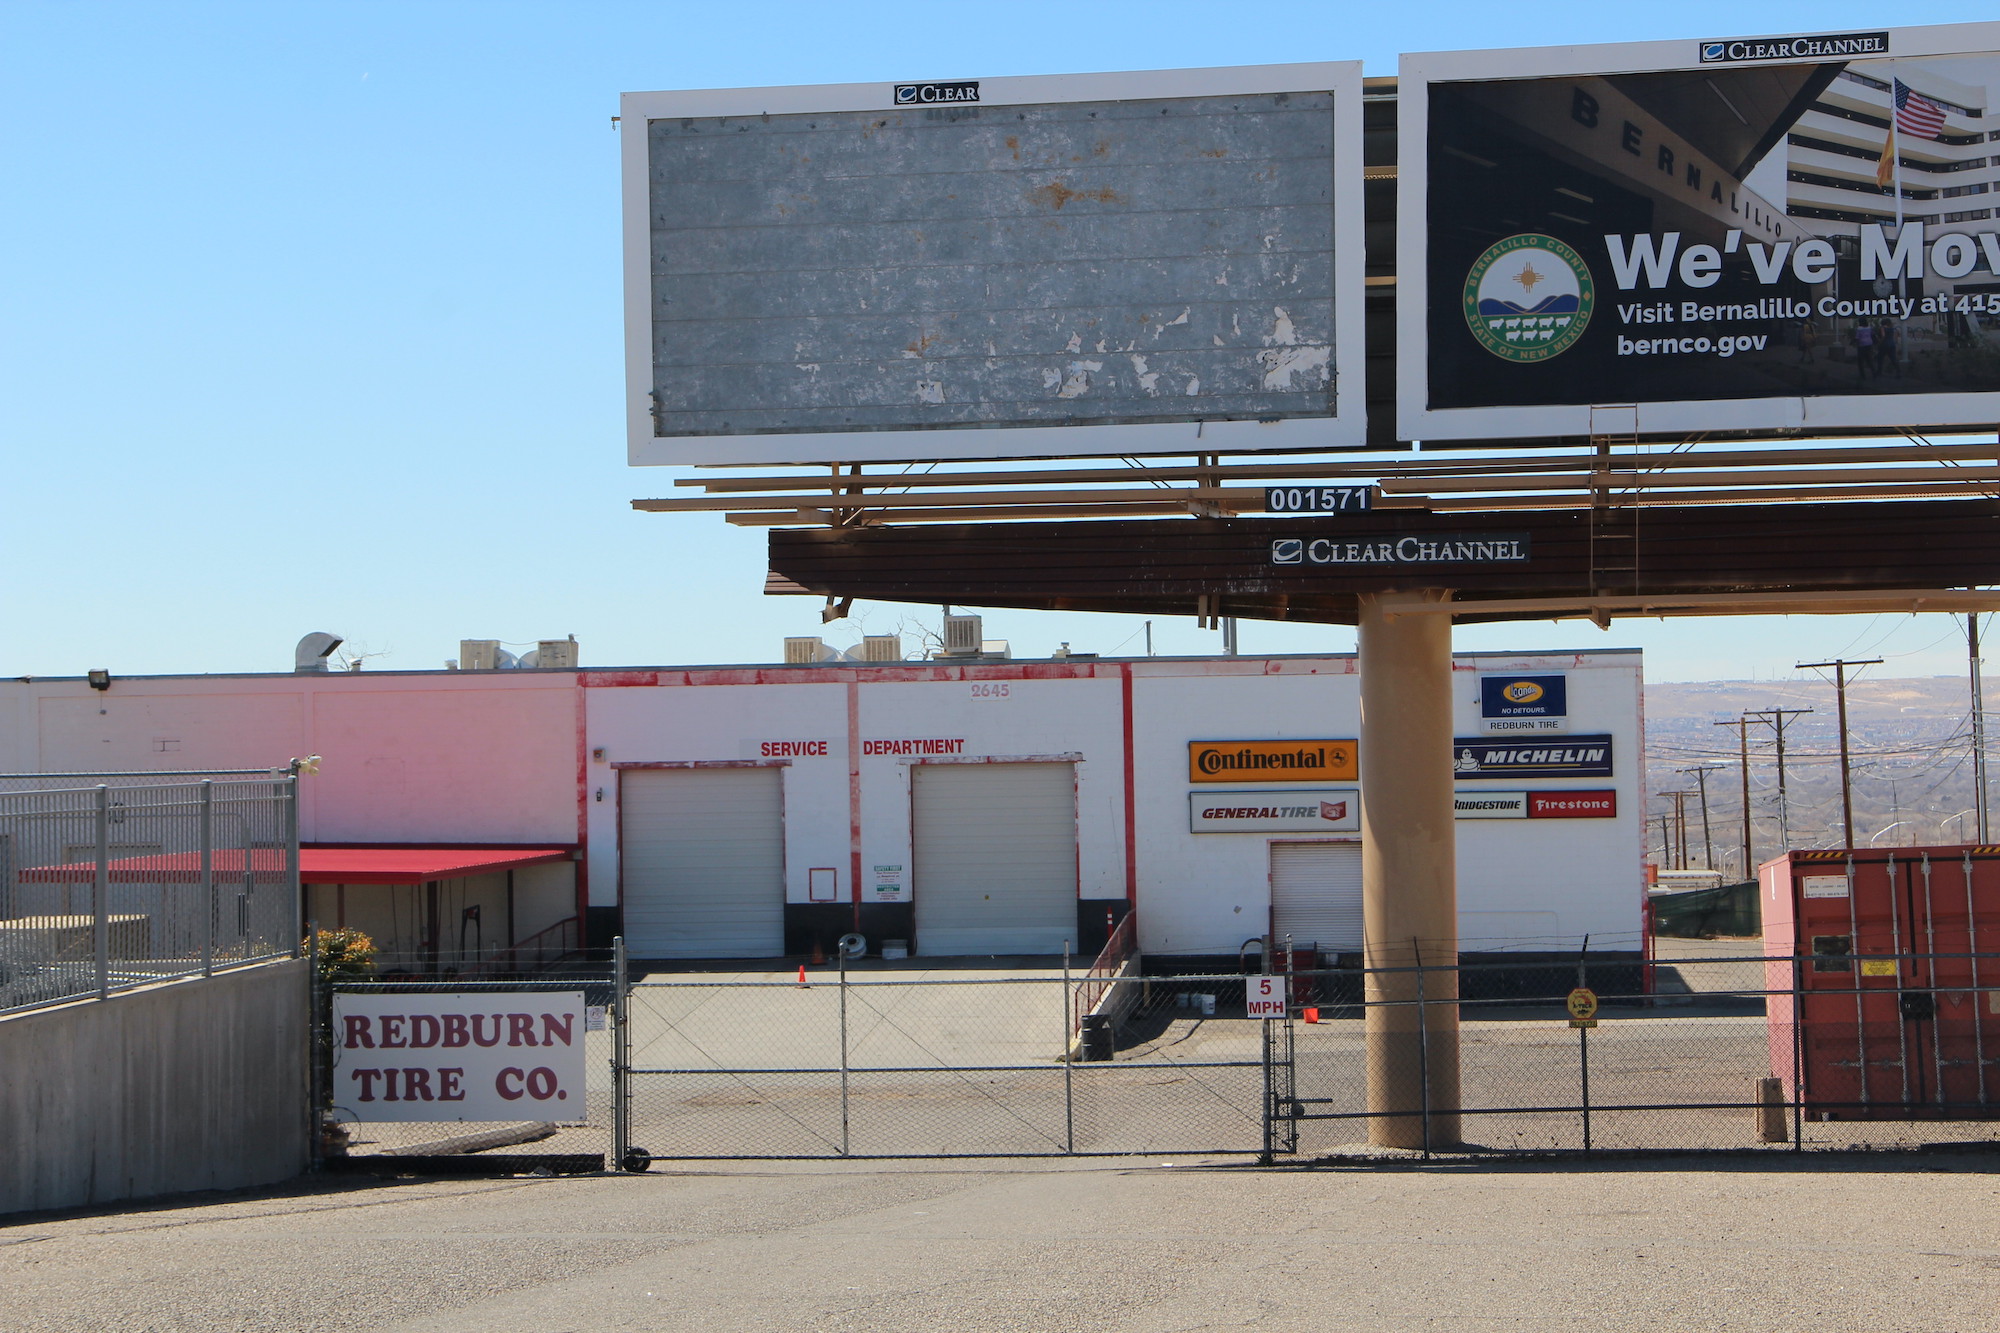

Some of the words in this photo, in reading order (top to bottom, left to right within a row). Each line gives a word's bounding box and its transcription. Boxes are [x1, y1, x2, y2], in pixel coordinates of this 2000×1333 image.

[1571, 86, 1782, 238] BERNALILLO
[1469, 237, 1538, 287] BERNALILLO
[1546, 240, 1589, 281] COUNTY
[1603, 229, 1836, 290] We've
[1617, 302, 1675, 324] Visit
[1681, 297, 1811, 322] Bernalillo
[1817, 295, 1914, 320] County
[1920, 292, 1949, 314] at
[1469, 314, 1496, 348] STATE
[1498, 346, 1515, 357] OF
[1520, 348, 1548, 359] NEW
[1553, 310, 1589, 351] MEXICO
[1617, 335, 1768, 357] bernco.gov
[1270, 488, 1366, 510] 001571
[971, 684, 1009, 697] 2645
[1490, 722, 1535, 730] REDBURN
[1539, 721, 1558, 729] TIRE
[761, 741, 827, 756] SERVICE
[863, 739, 964, 755] DEPARTMENT
[1484, 749, 1604, 763] MICHELIN
[1198, 748, 1326, 775] Continental
[1536, 800, 1609, 811] Firestone
[1260, 979, 1272, 995] 5
[1248, 1001, 1284, 1014] MPH
[343, 1013, 574, 1048] REDBURN
[352, 1067, 466, 1101] TIRE
[495, 1066, 567, 1100] CO.
